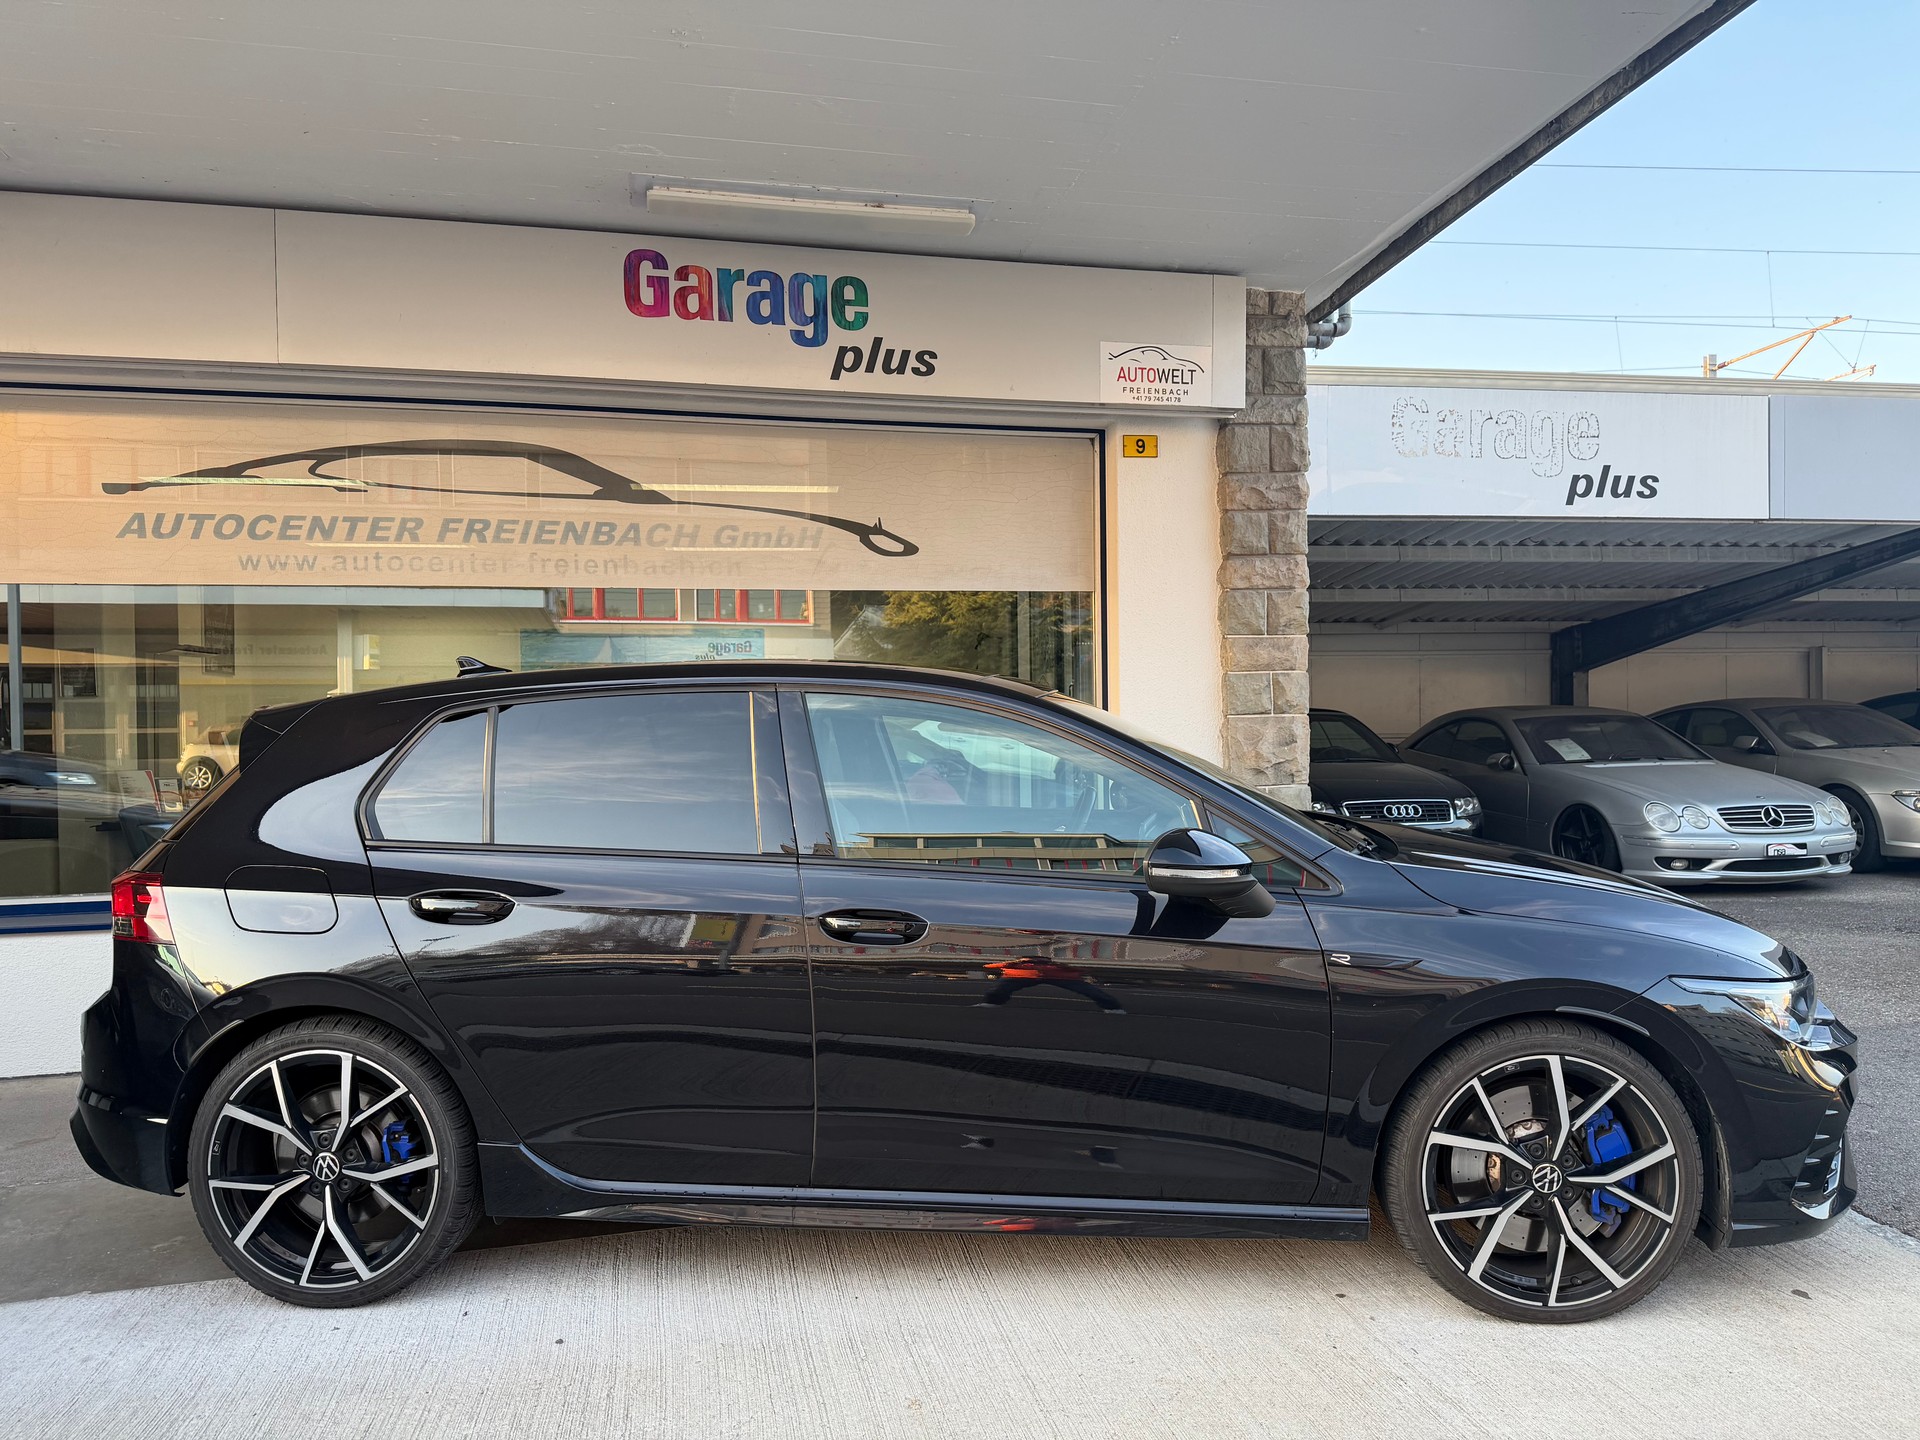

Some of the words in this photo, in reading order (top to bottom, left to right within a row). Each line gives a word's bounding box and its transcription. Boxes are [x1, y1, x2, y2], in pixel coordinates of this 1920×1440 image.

[623, 249, 869, 348] Garage
[830, 336, 938, 380] plus
[1117, 366, 1196, 385] AUTOWELT
[1122, 387, 1189, 396] FREIENBACH
[1135, 438, 1146, 454] 9
[1391, 396, 1600, 478] Garage
[1565, 464, 1660, 505] plus
[116, 512, 424, 543] AUTOCENTER
[436, 517, 701, 547] FREIENBACH
[713, 524, 824, 549] GmbH
